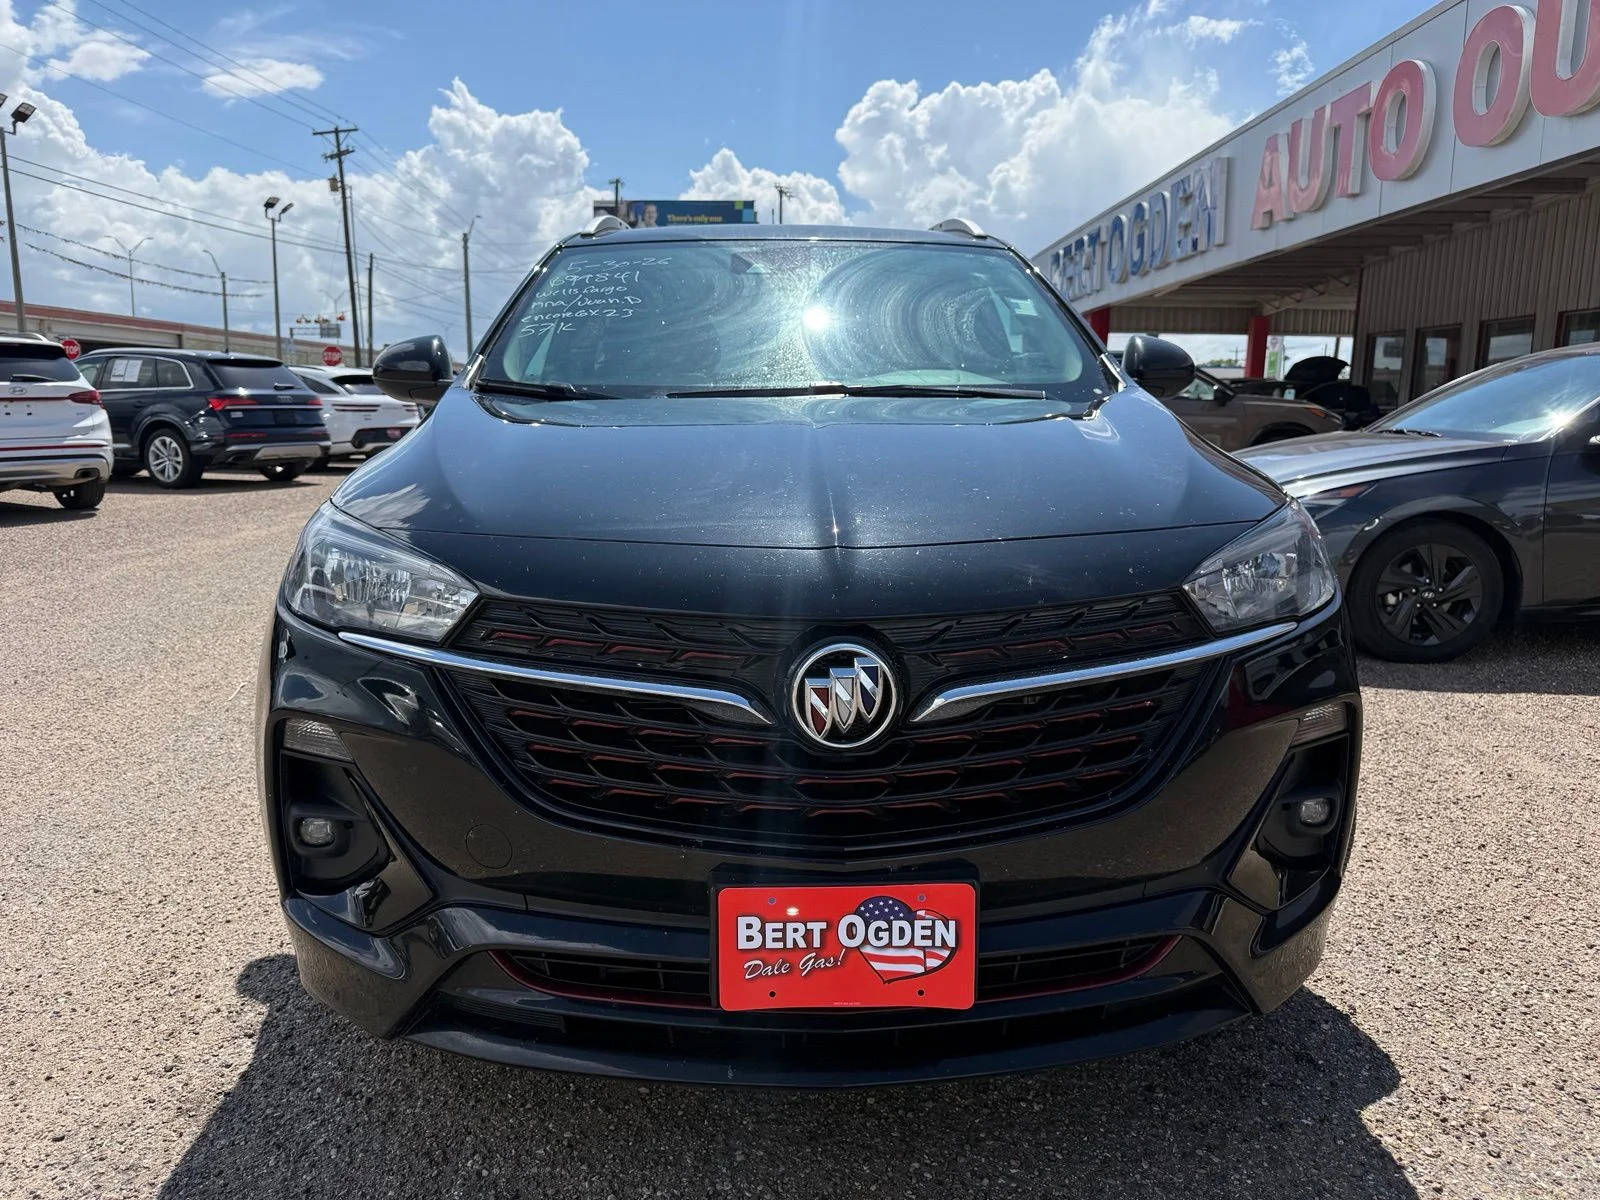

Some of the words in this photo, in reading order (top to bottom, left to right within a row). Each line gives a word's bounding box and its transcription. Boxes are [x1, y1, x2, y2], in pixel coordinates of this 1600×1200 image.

[1108, 157, 1230, 284] OGDEN
[1251, 59, 1437, 231] AUTO
[667, 213, 692, 222] There's
[323, 351, 342, 361] STOP
[736, 915, 828, 950] BERT
[837, 914, 956, 948] OGDEN
[743, 958, 791, 980] Dale
[799, 948, 846, 977] Gas!
